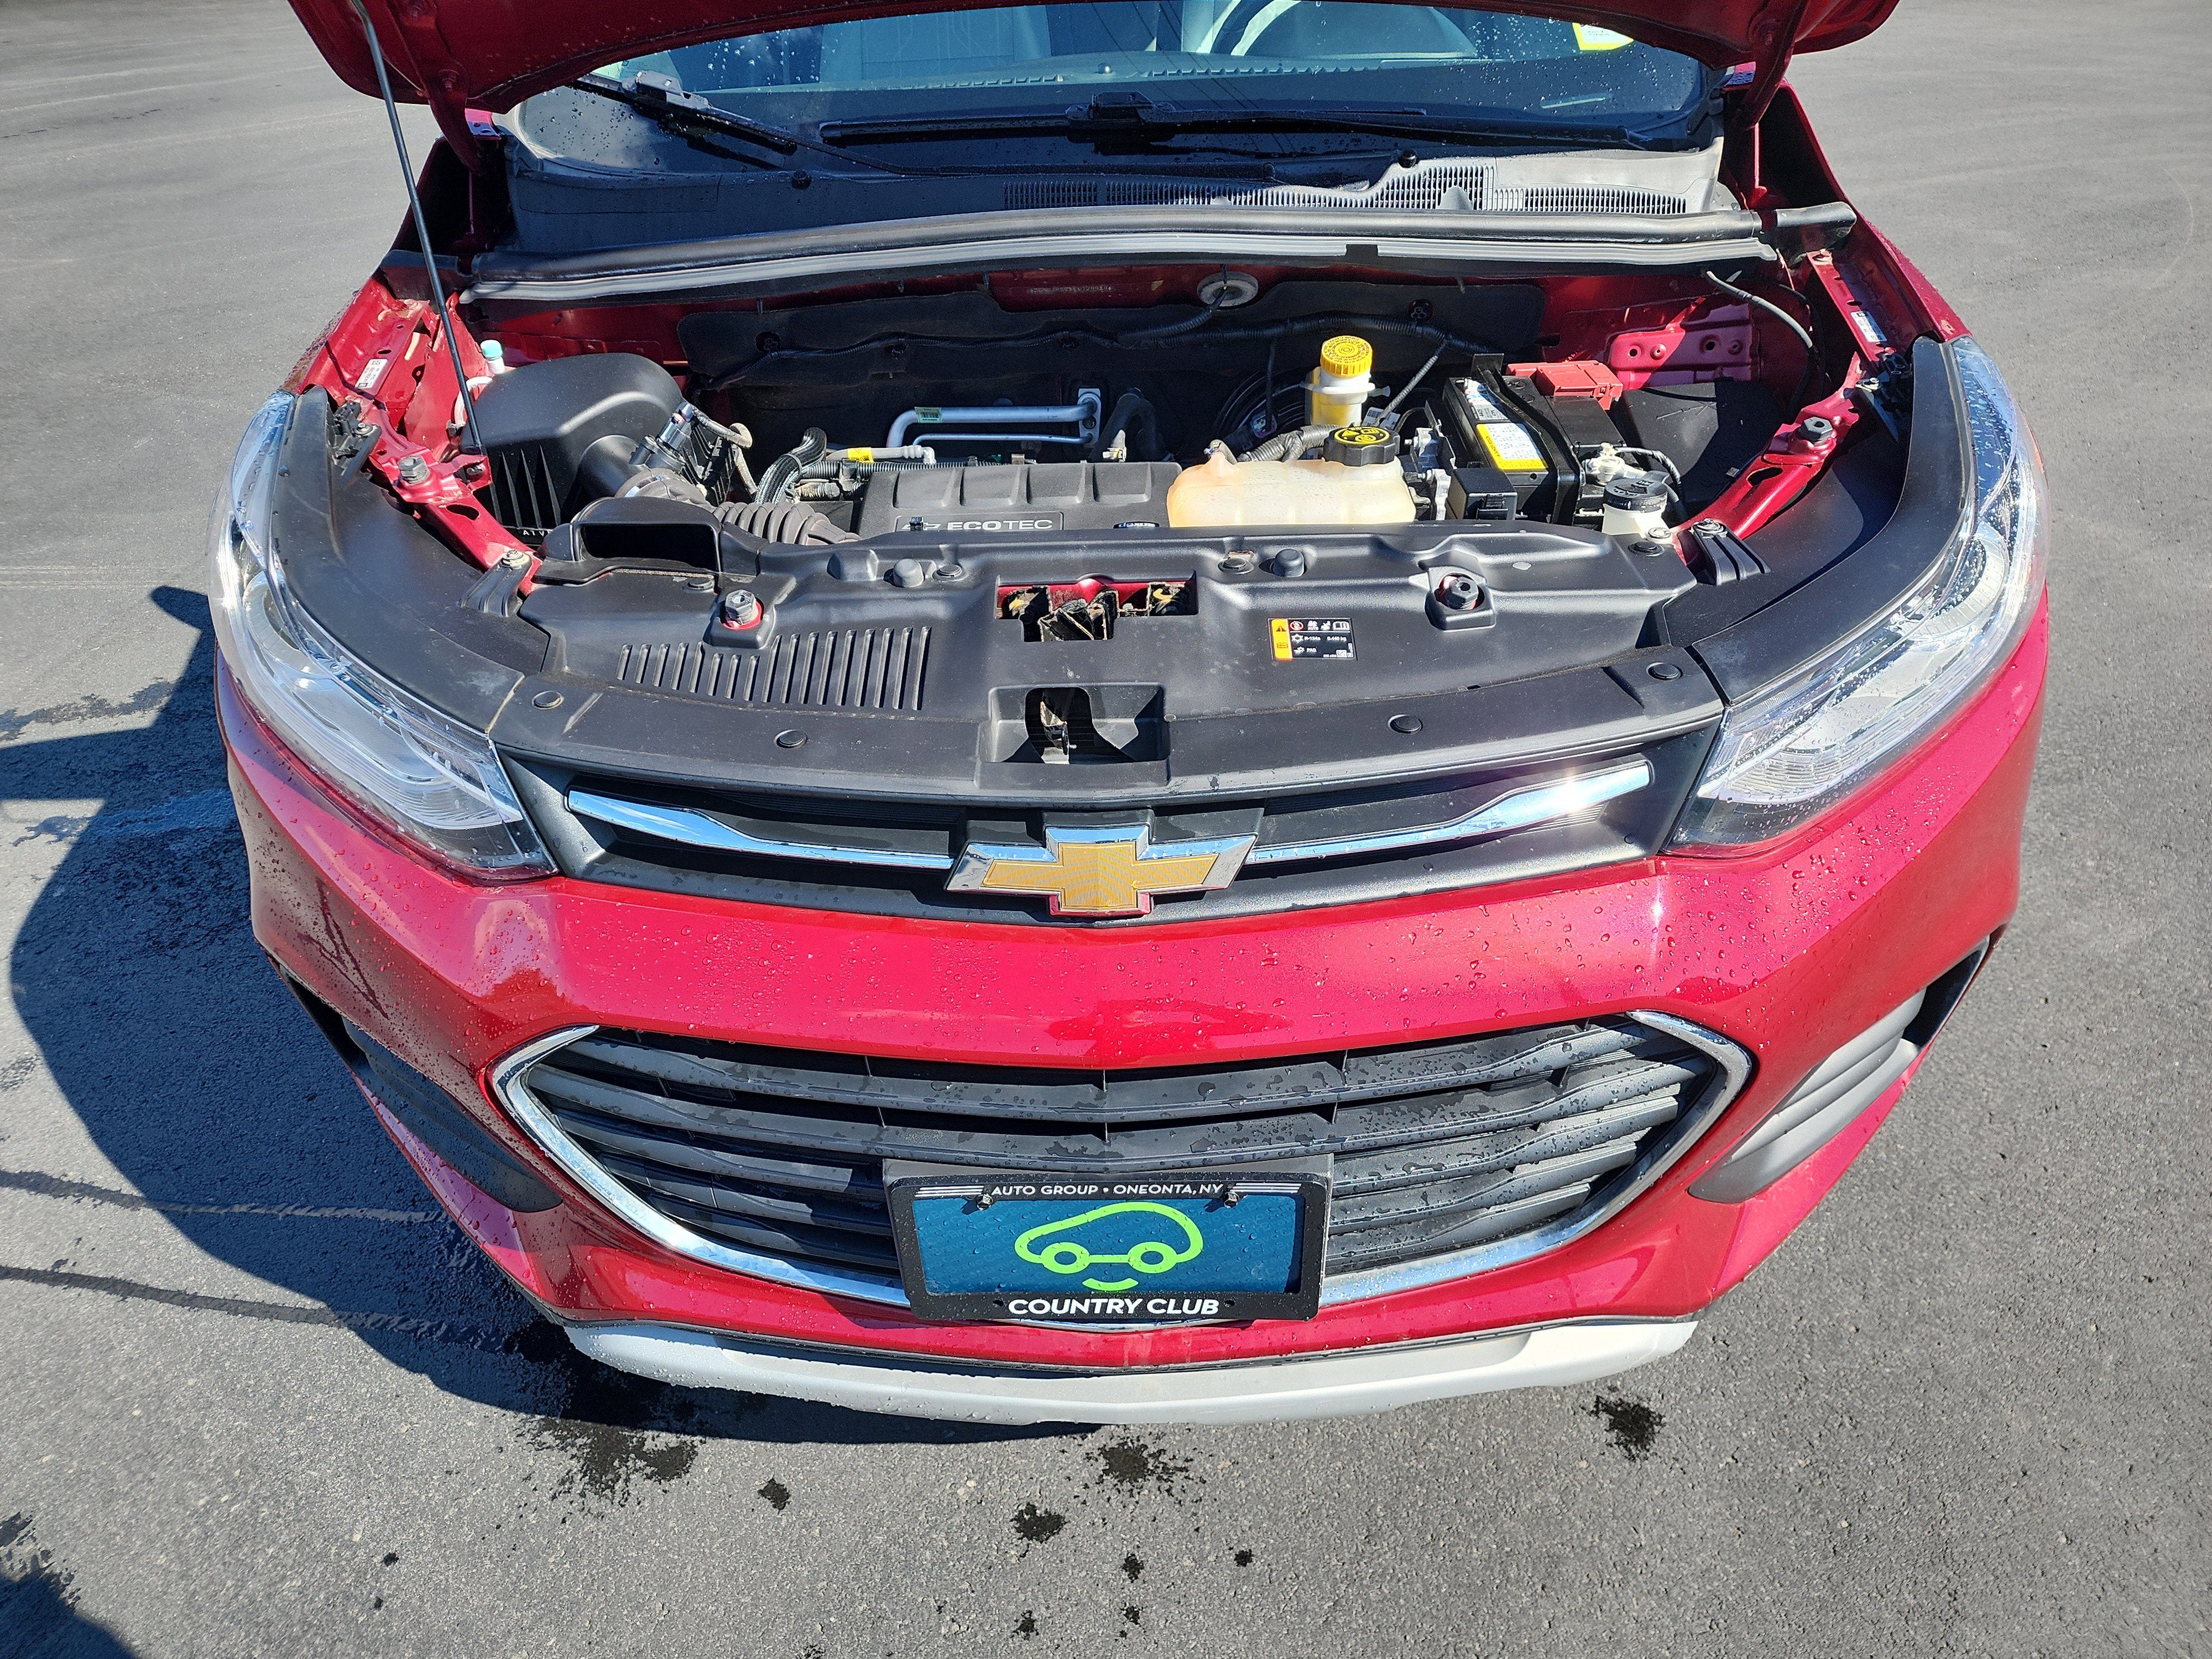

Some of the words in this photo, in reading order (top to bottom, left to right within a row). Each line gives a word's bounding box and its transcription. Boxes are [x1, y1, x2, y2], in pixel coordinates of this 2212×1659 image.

[947, 520, 1053, 530] ECOTEC
[991, 1185, 1036, 1196] AUTO
[1041, 1185, 1098, 1195] GROUP
[1008, 1298, 1143, 1314] COUNTRY
[1146, 1298, 1219, 1315] CLUB
